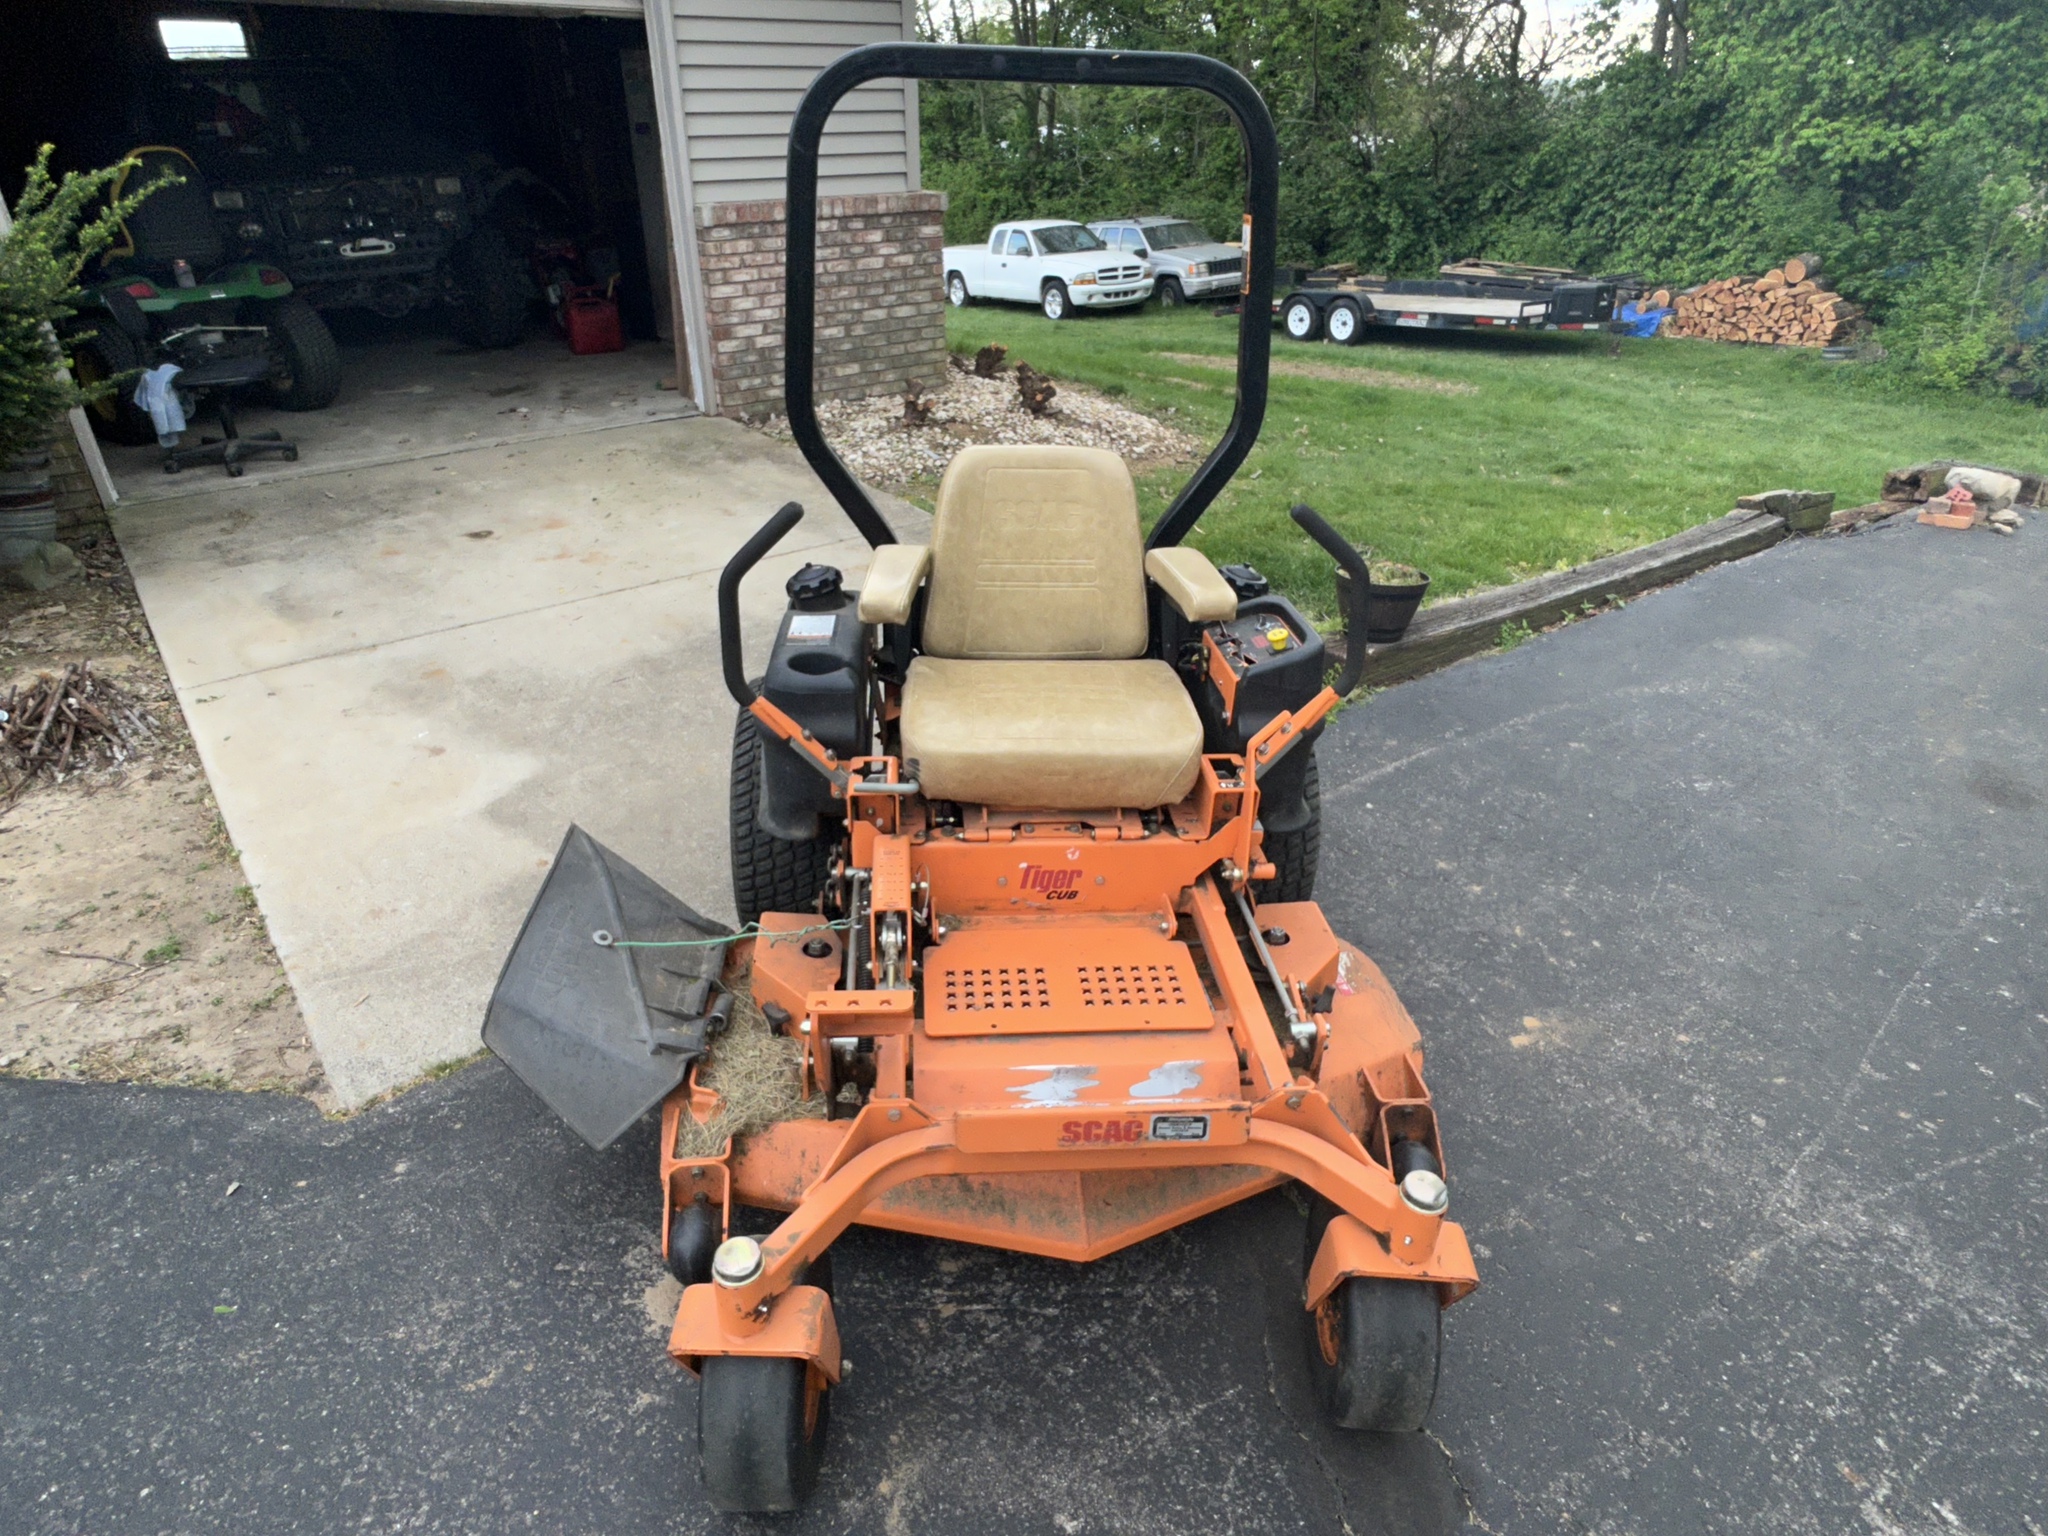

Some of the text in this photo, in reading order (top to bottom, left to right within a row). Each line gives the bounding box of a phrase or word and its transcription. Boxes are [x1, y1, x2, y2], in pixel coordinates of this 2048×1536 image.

[1020, 865, 1083, 893] Tiger
[1046, 890, 1079, 900] CUB
[1062, 1120, 1143, 1143] SCAG
